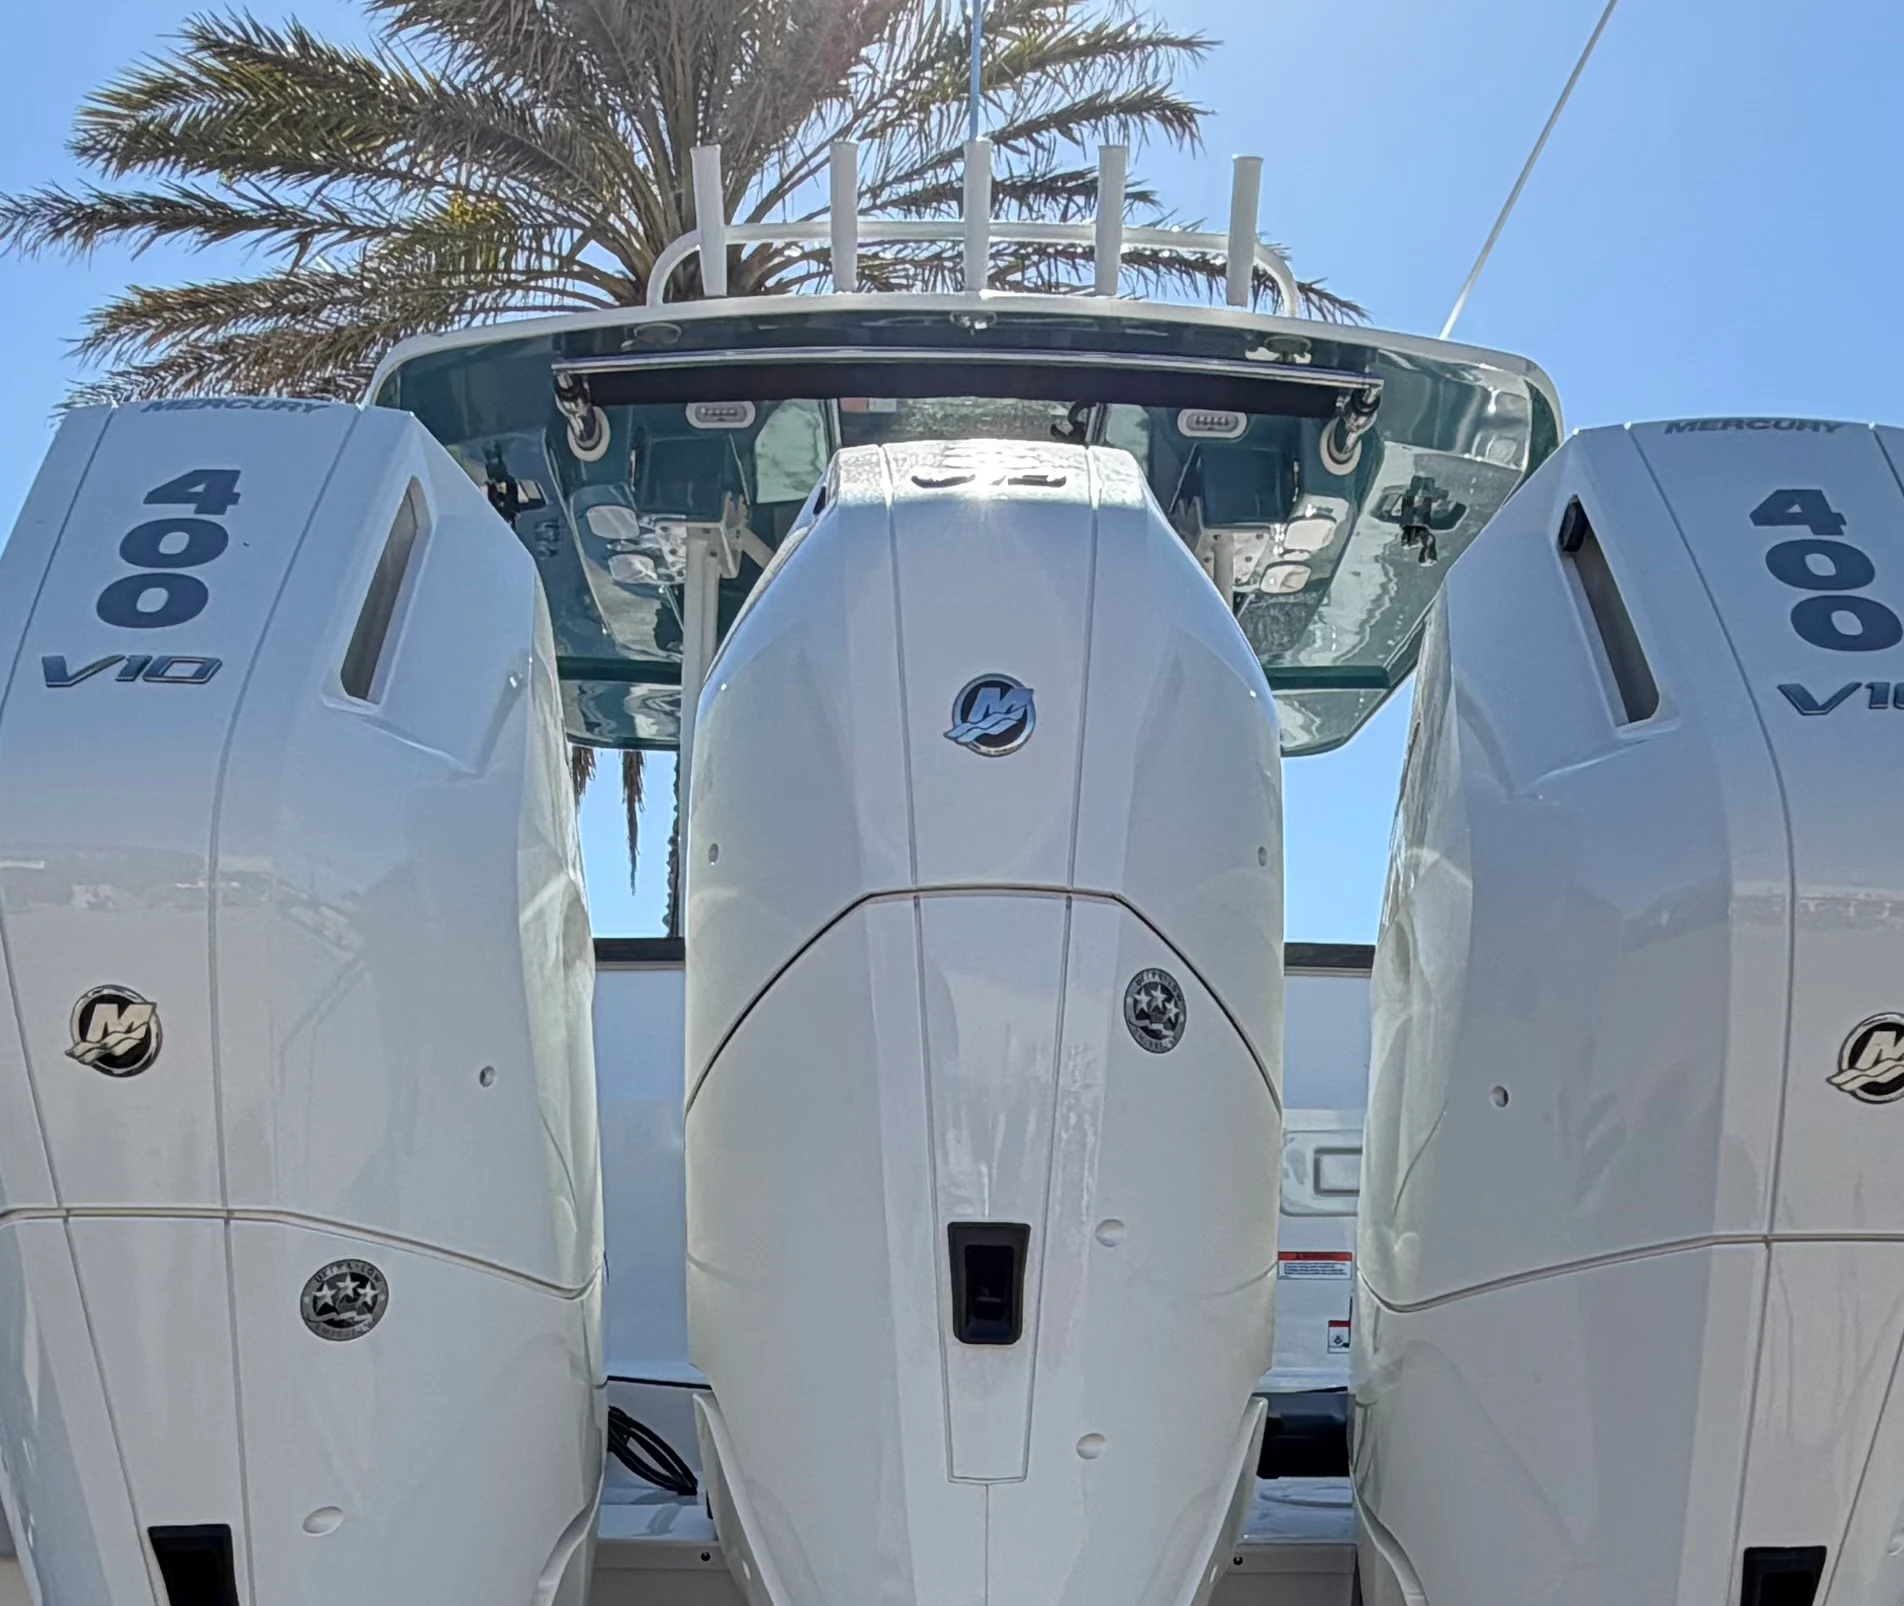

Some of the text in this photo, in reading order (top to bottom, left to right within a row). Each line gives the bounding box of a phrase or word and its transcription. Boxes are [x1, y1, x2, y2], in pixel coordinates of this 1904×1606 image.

[96, 469, 242, 629] 400
[1749, 488, 1904, 652] 400
[41, 654, 223, 688] V10
